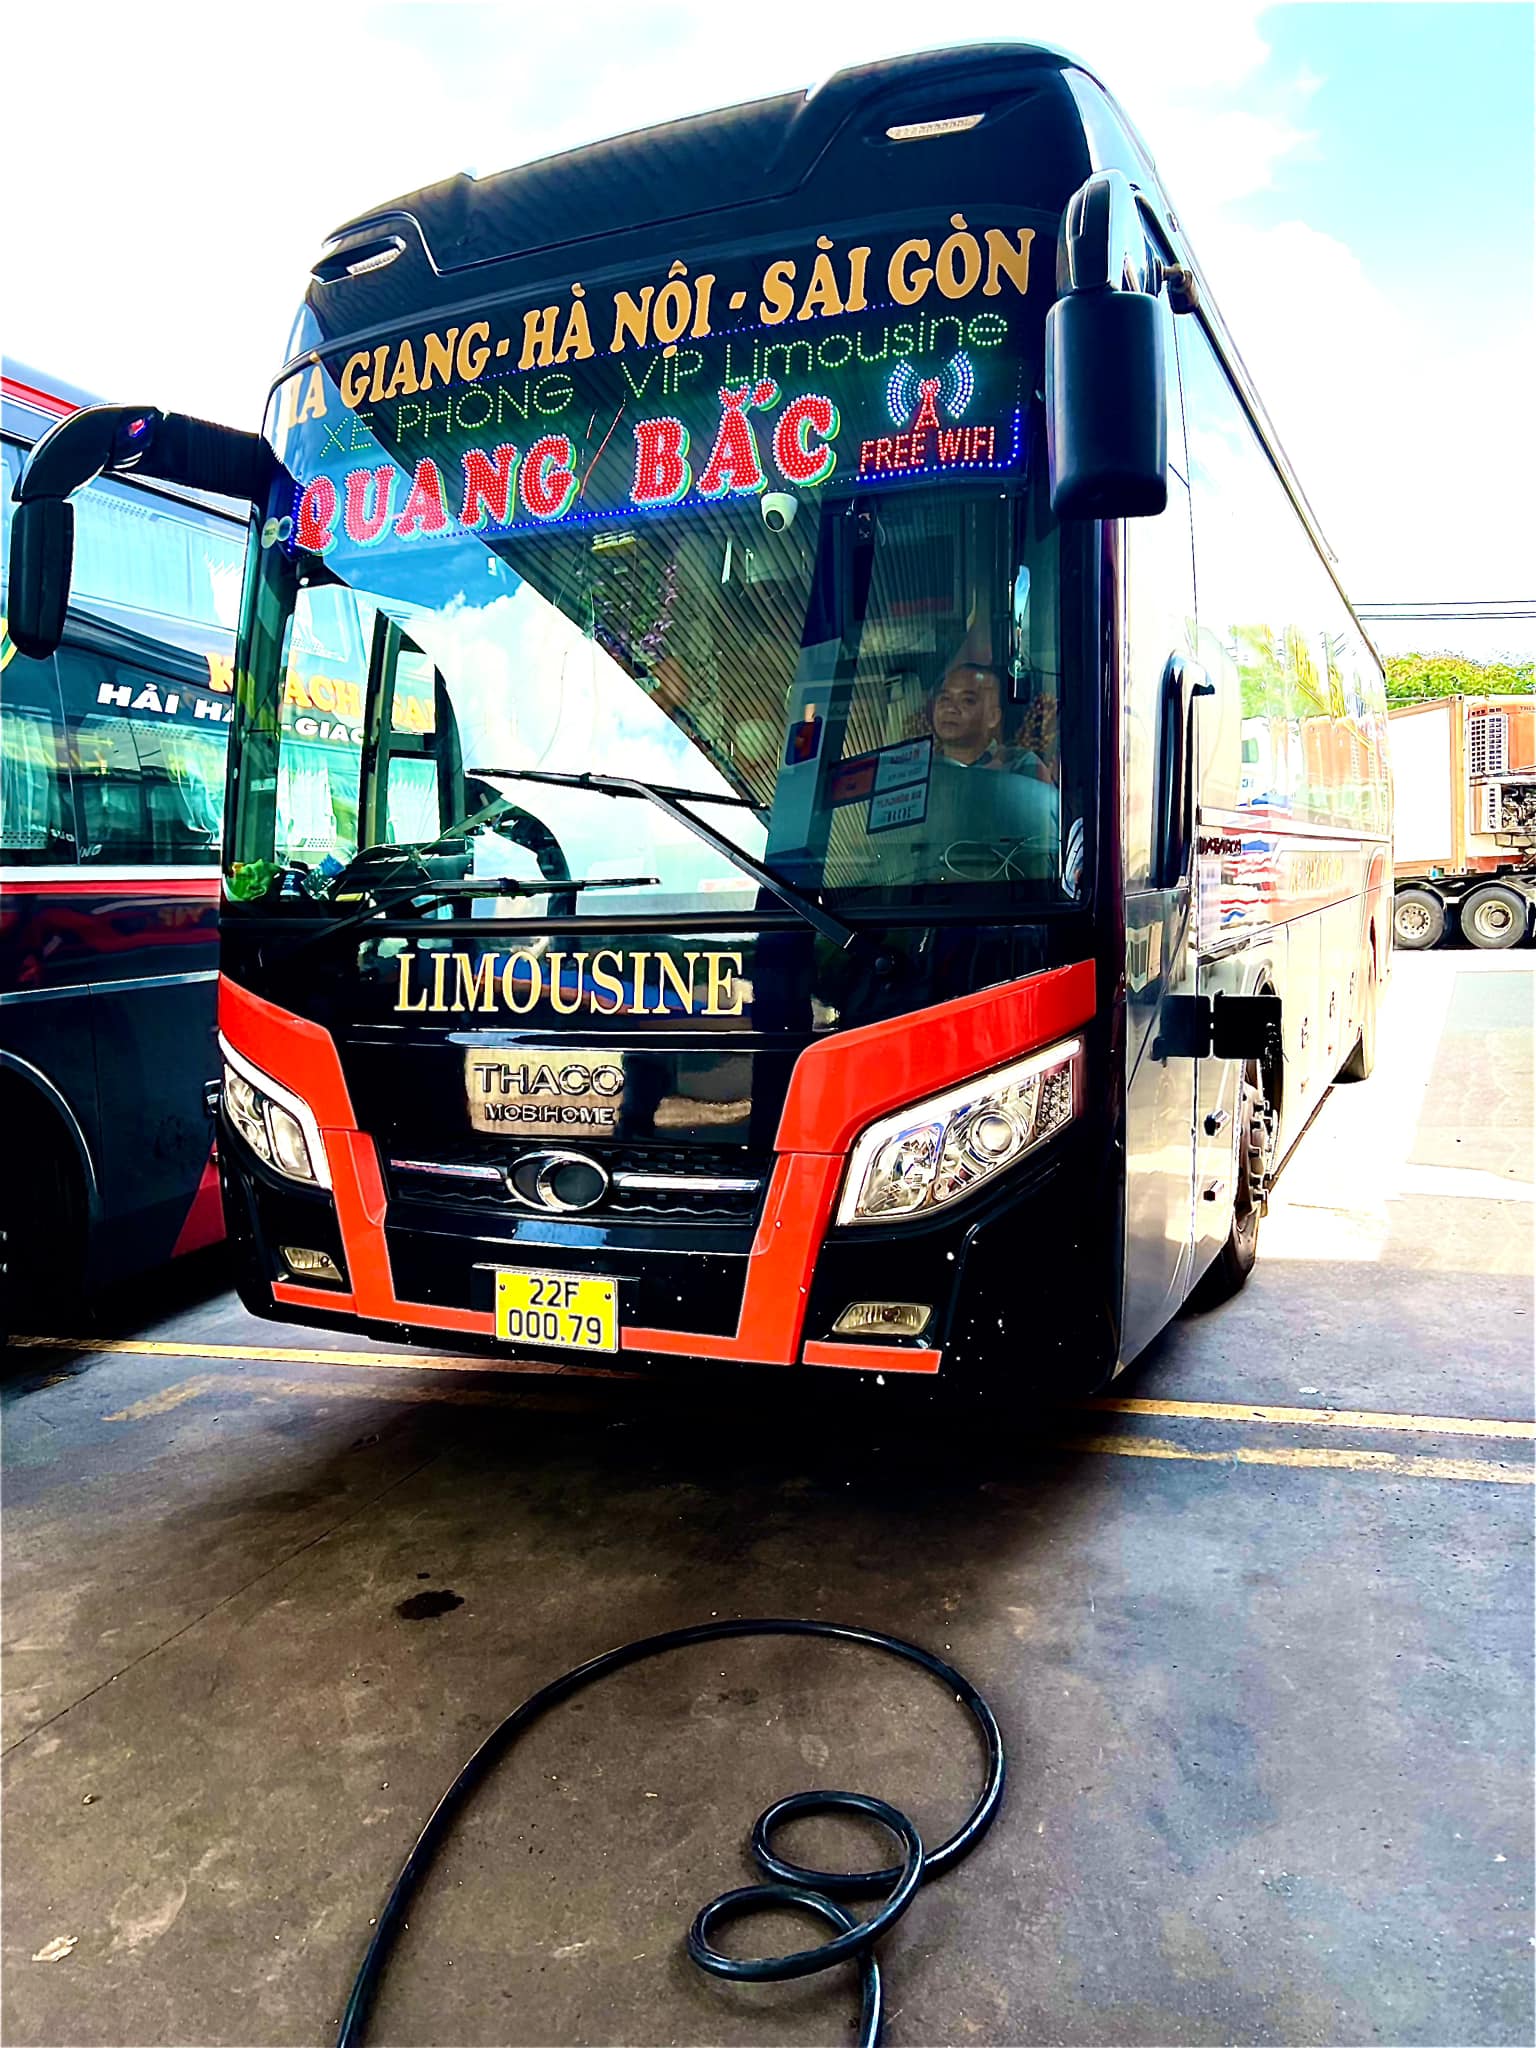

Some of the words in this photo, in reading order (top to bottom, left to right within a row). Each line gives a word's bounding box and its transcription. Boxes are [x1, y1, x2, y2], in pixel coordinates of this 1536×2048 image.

[609, 260, 716, 358] NỘI
[759, 235, 871, 325] SÀI
[887, 213, 1036, 306] GÒN
[320, 411, 375, 457] XE
[725, 311, 1008, 384] Limousine
[294, 433, 582, 556] QUANG
[629, 377, 841, 507] BẮC
[859, 432, 926, 473] FREE
[937, 426, 996, 462] WIFI
[97, 682, 180, 714] HẢI
[393, 950, 745, 1016] LIMOUSINE
[473, 1062, 625, 1097] THACO
[484, 1102, 616, 1126] MOBIHOME
[528, 1277, 580, 1309] 22F
[507, 1308, 602, 1345] 000.79
